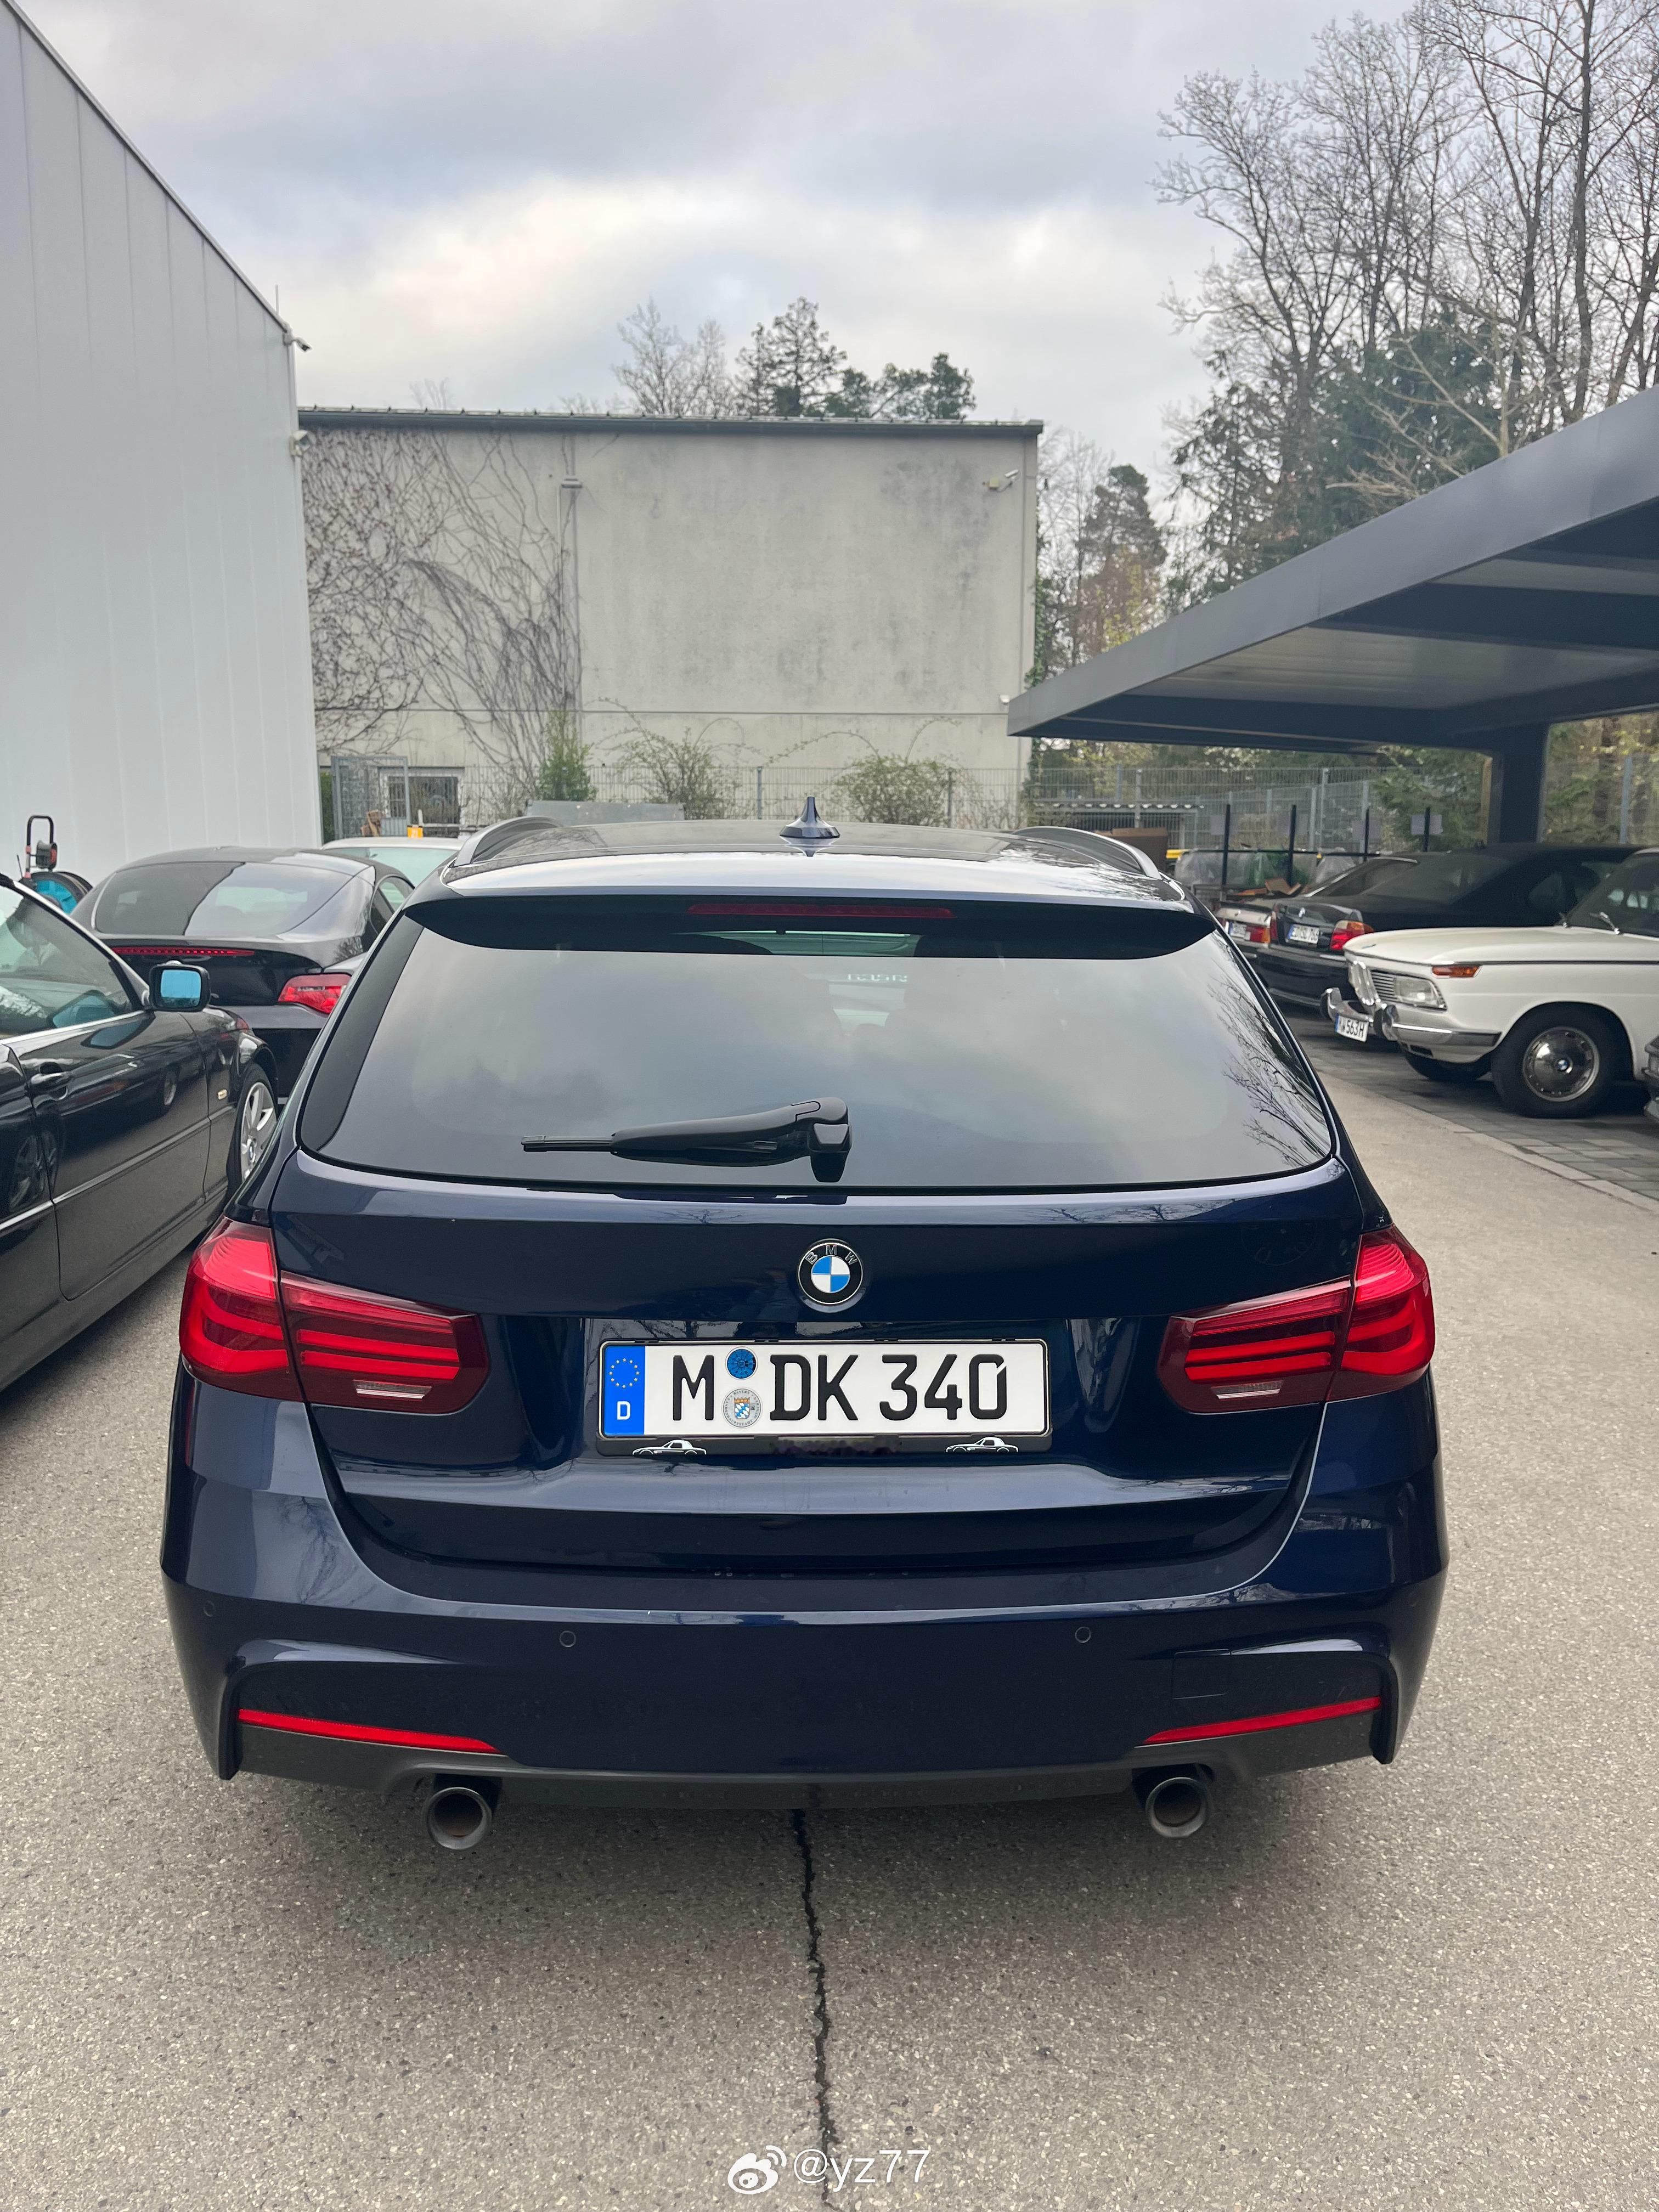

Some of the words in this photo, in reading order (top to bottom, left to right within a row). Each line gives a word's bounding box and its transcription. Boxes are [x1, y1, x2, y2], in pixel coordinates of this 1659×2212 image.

[805, 1245, 858, 1265] BMW
[673, 1355, 715, 1421] M
[769, 1354, 859, 1421] DK
[879, 1354, 1007, 1421] 340
[617, 1401, 631, 1420] D
